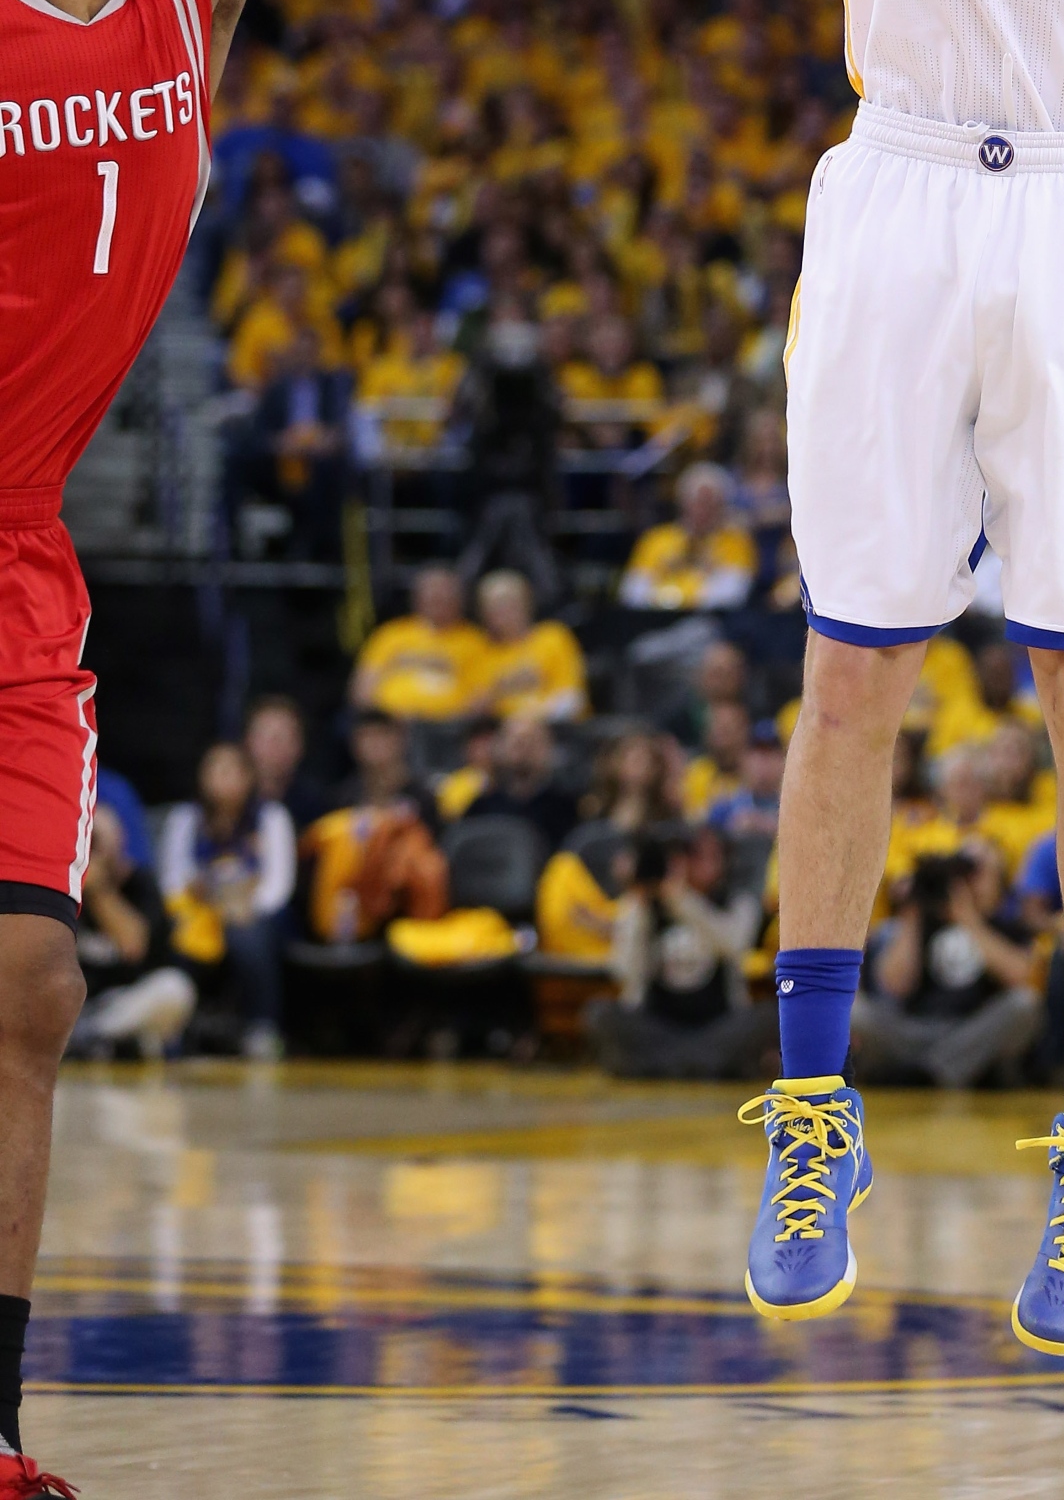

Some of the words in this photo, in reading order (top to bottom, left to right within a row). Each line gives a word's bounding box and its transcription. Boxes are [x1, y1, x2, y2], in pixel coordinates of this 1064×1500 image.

[0, 71, 193, 158] ROCKETS
[982, 144, 1010, 164] W
[93, 160, 119, 274] 1
